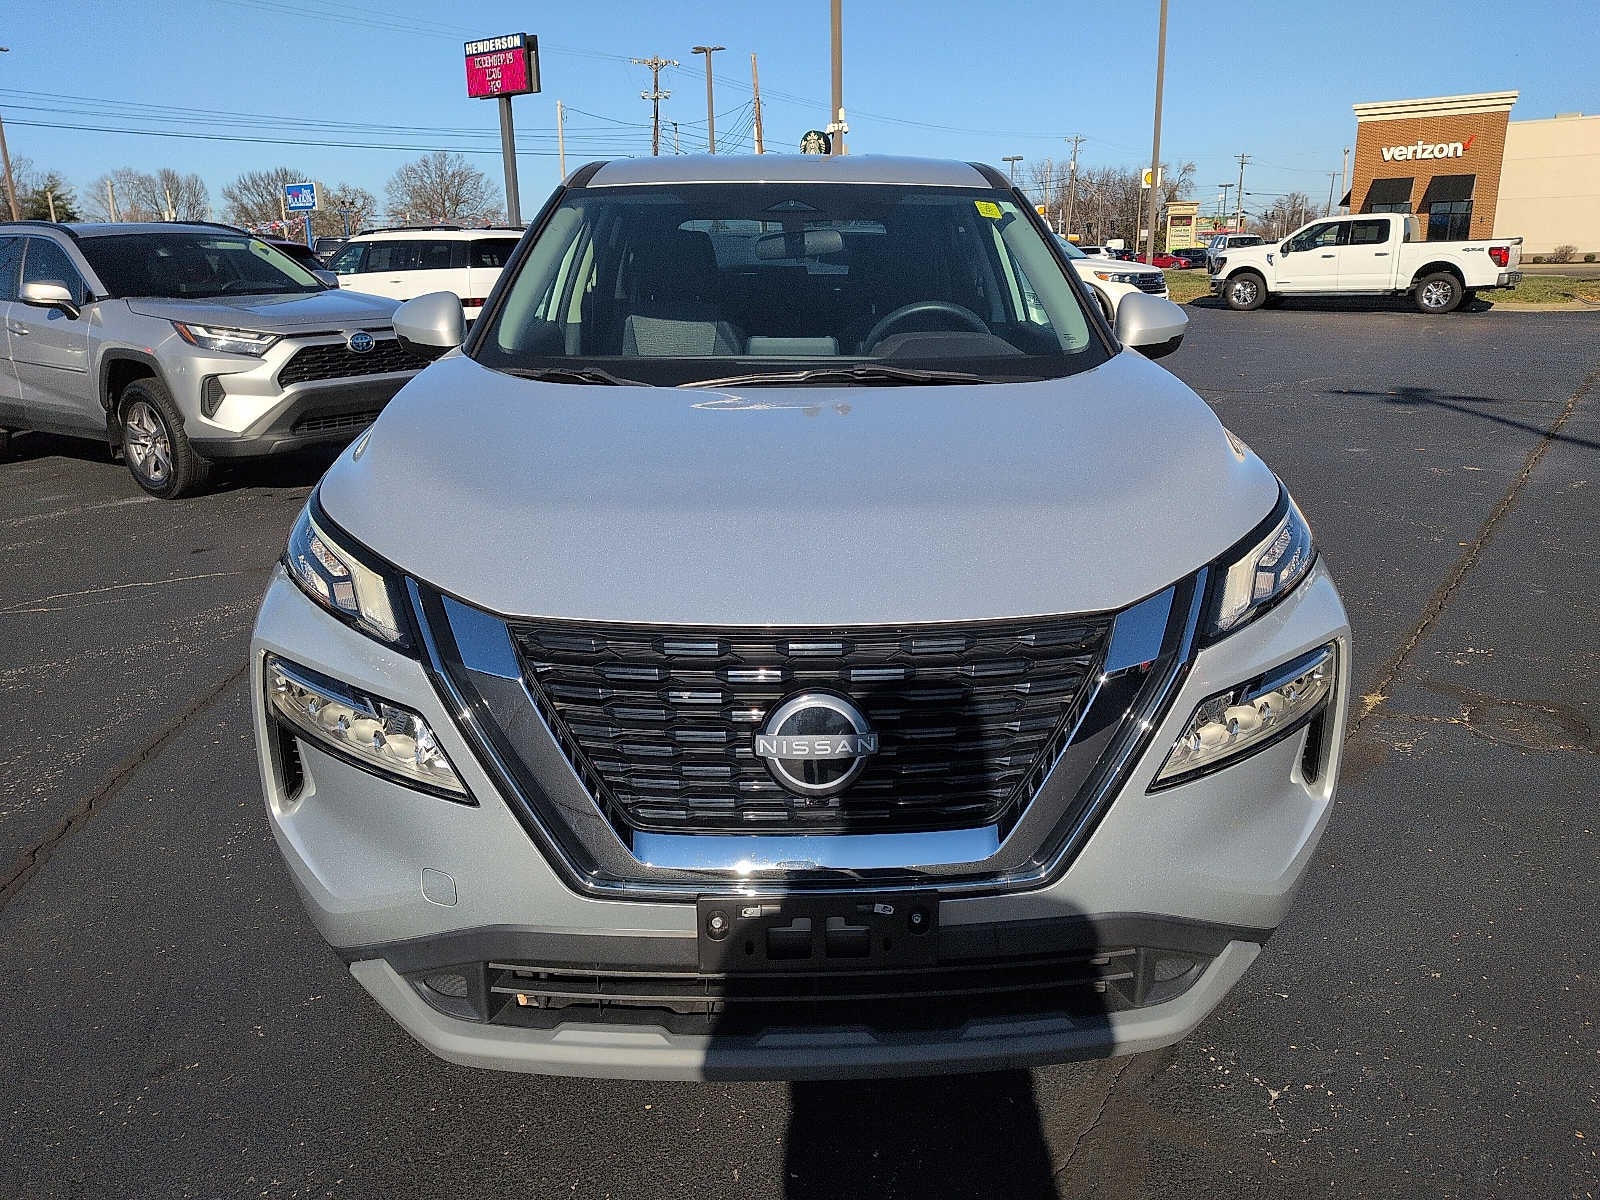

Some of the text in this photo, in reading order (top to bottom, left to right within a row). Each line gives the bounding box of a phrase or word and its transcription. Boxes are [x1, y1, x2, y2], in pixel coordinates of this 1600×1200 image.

[465, 35, 521, 55] HENDERSON
[1381, 140, 1463, 161] verizon
[759, 737, 874, 755] NISSAN
